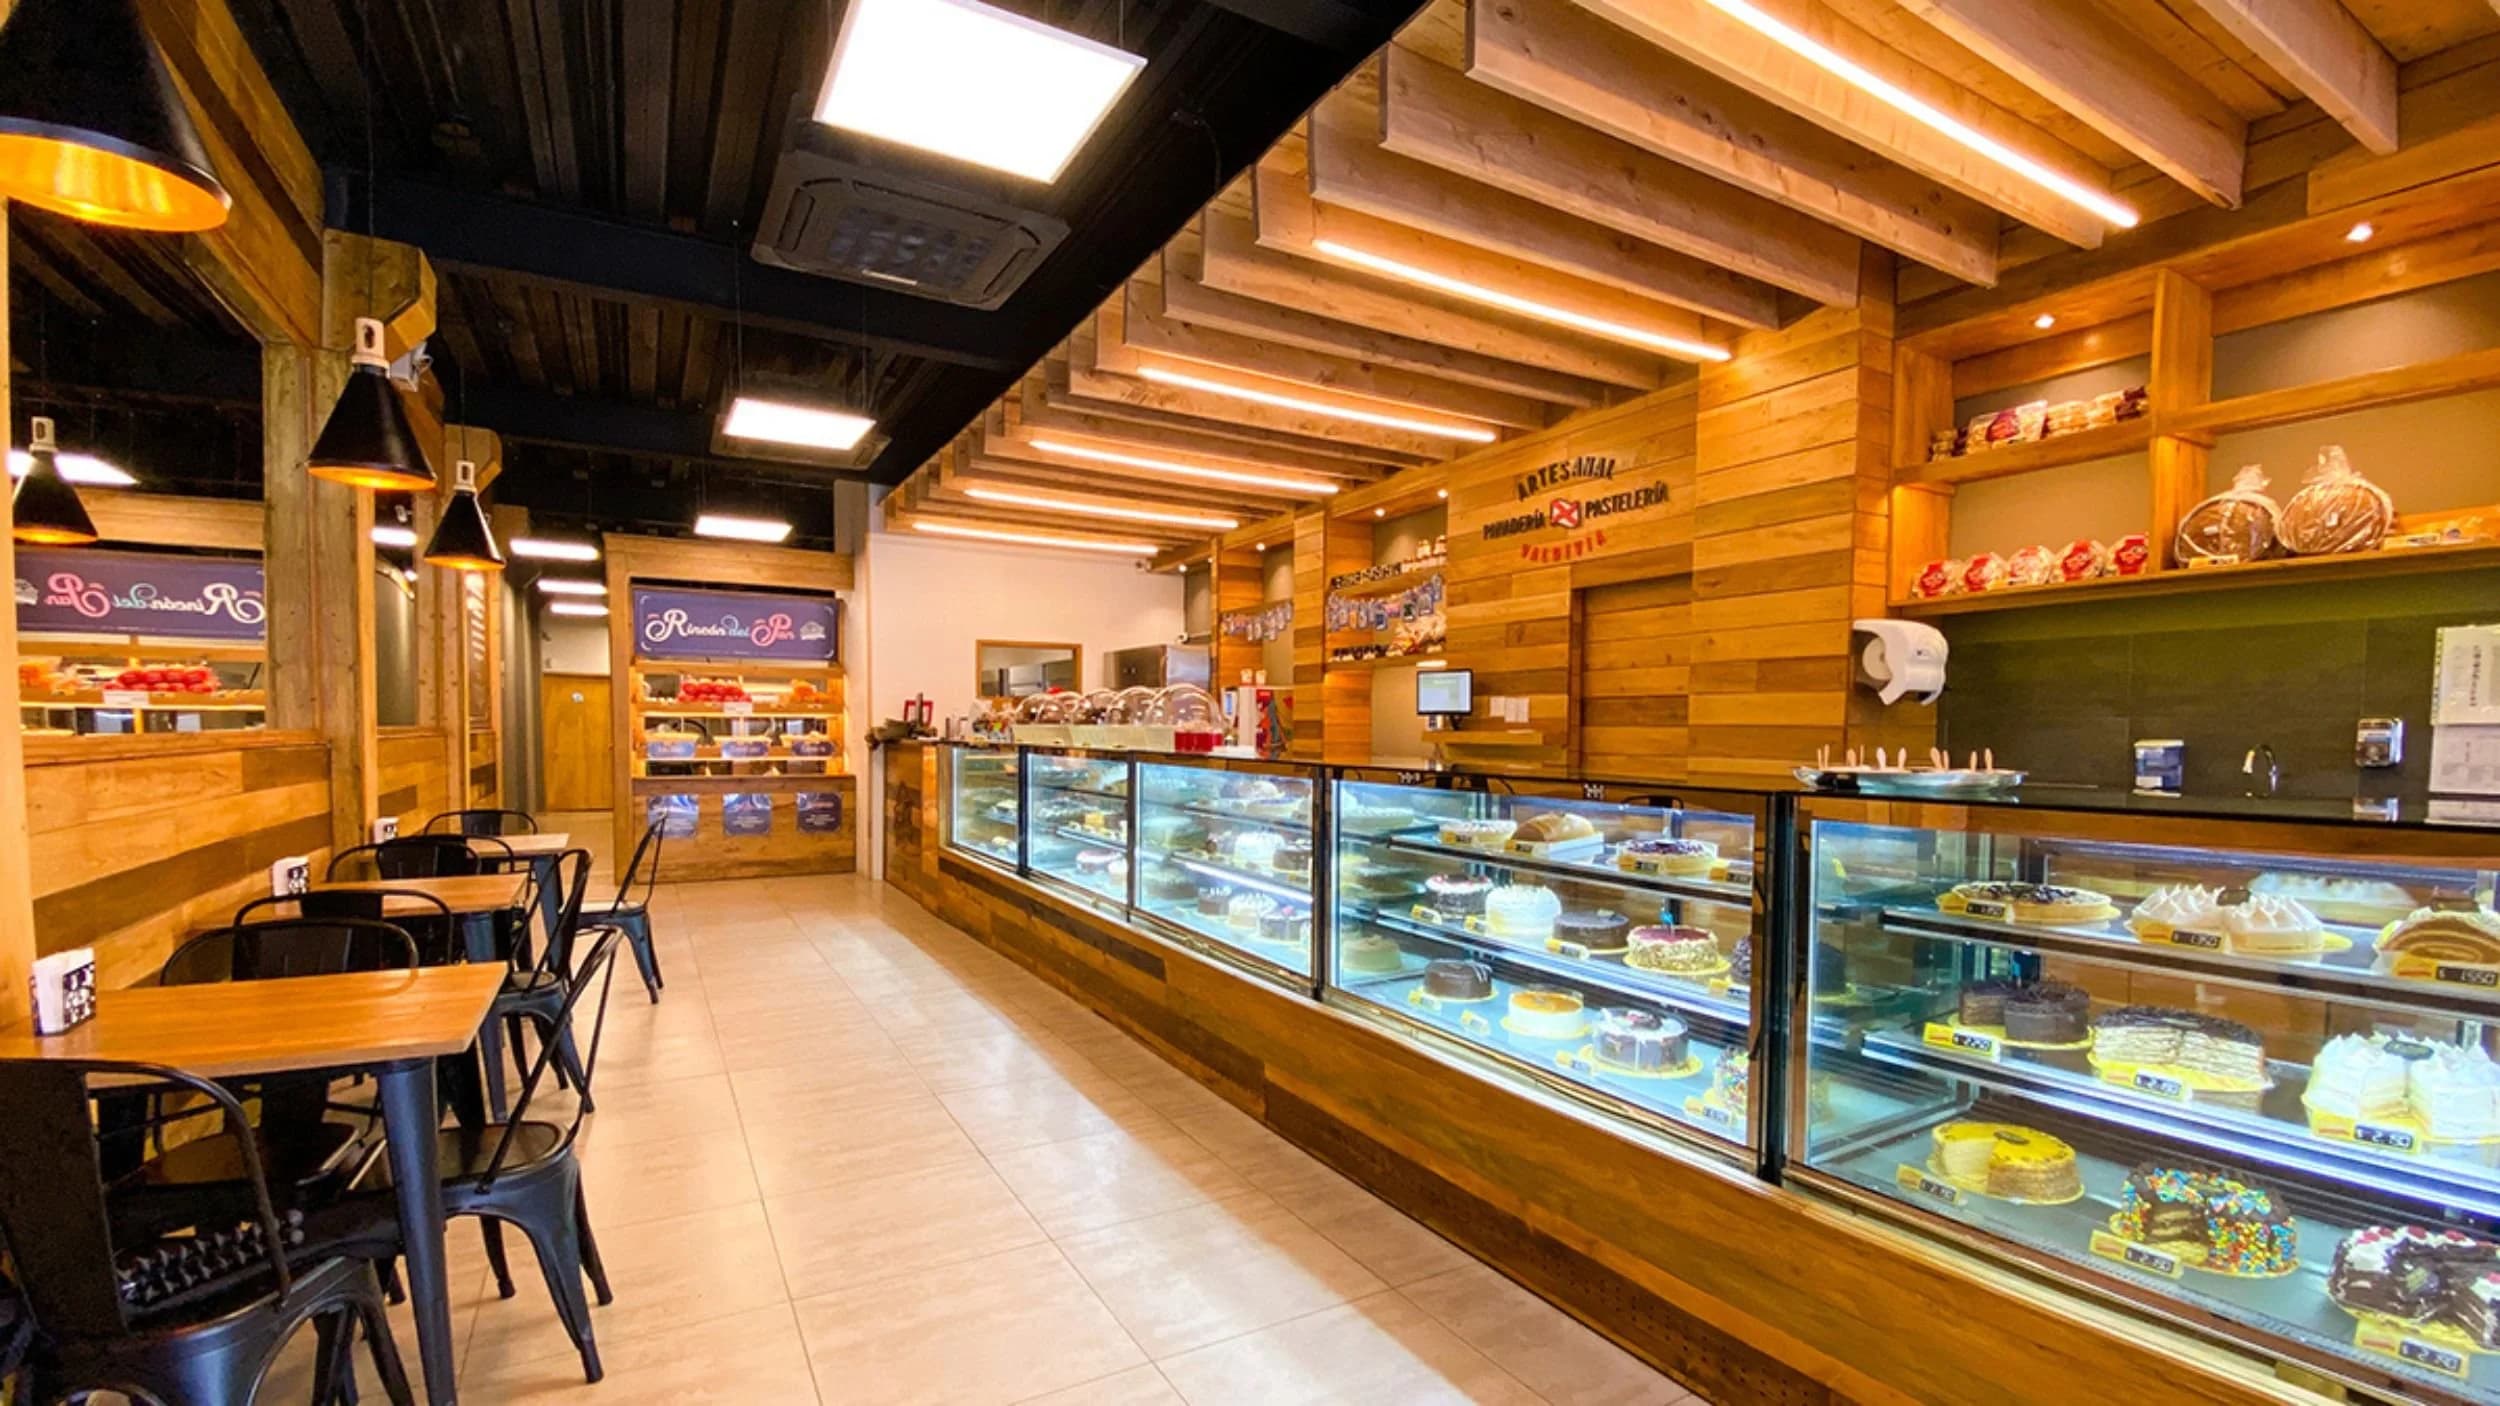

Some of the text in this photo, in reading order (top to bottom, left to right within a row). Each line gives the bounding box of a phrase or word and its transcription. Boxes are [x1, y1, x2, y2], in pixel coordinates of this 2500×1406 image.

[1517, 457, 1616, 501] ARTESANAL
[1483, 480, 1670, 540] PANADERÍA PASTELERÍA
[750, 613, 795, 647] Pan
